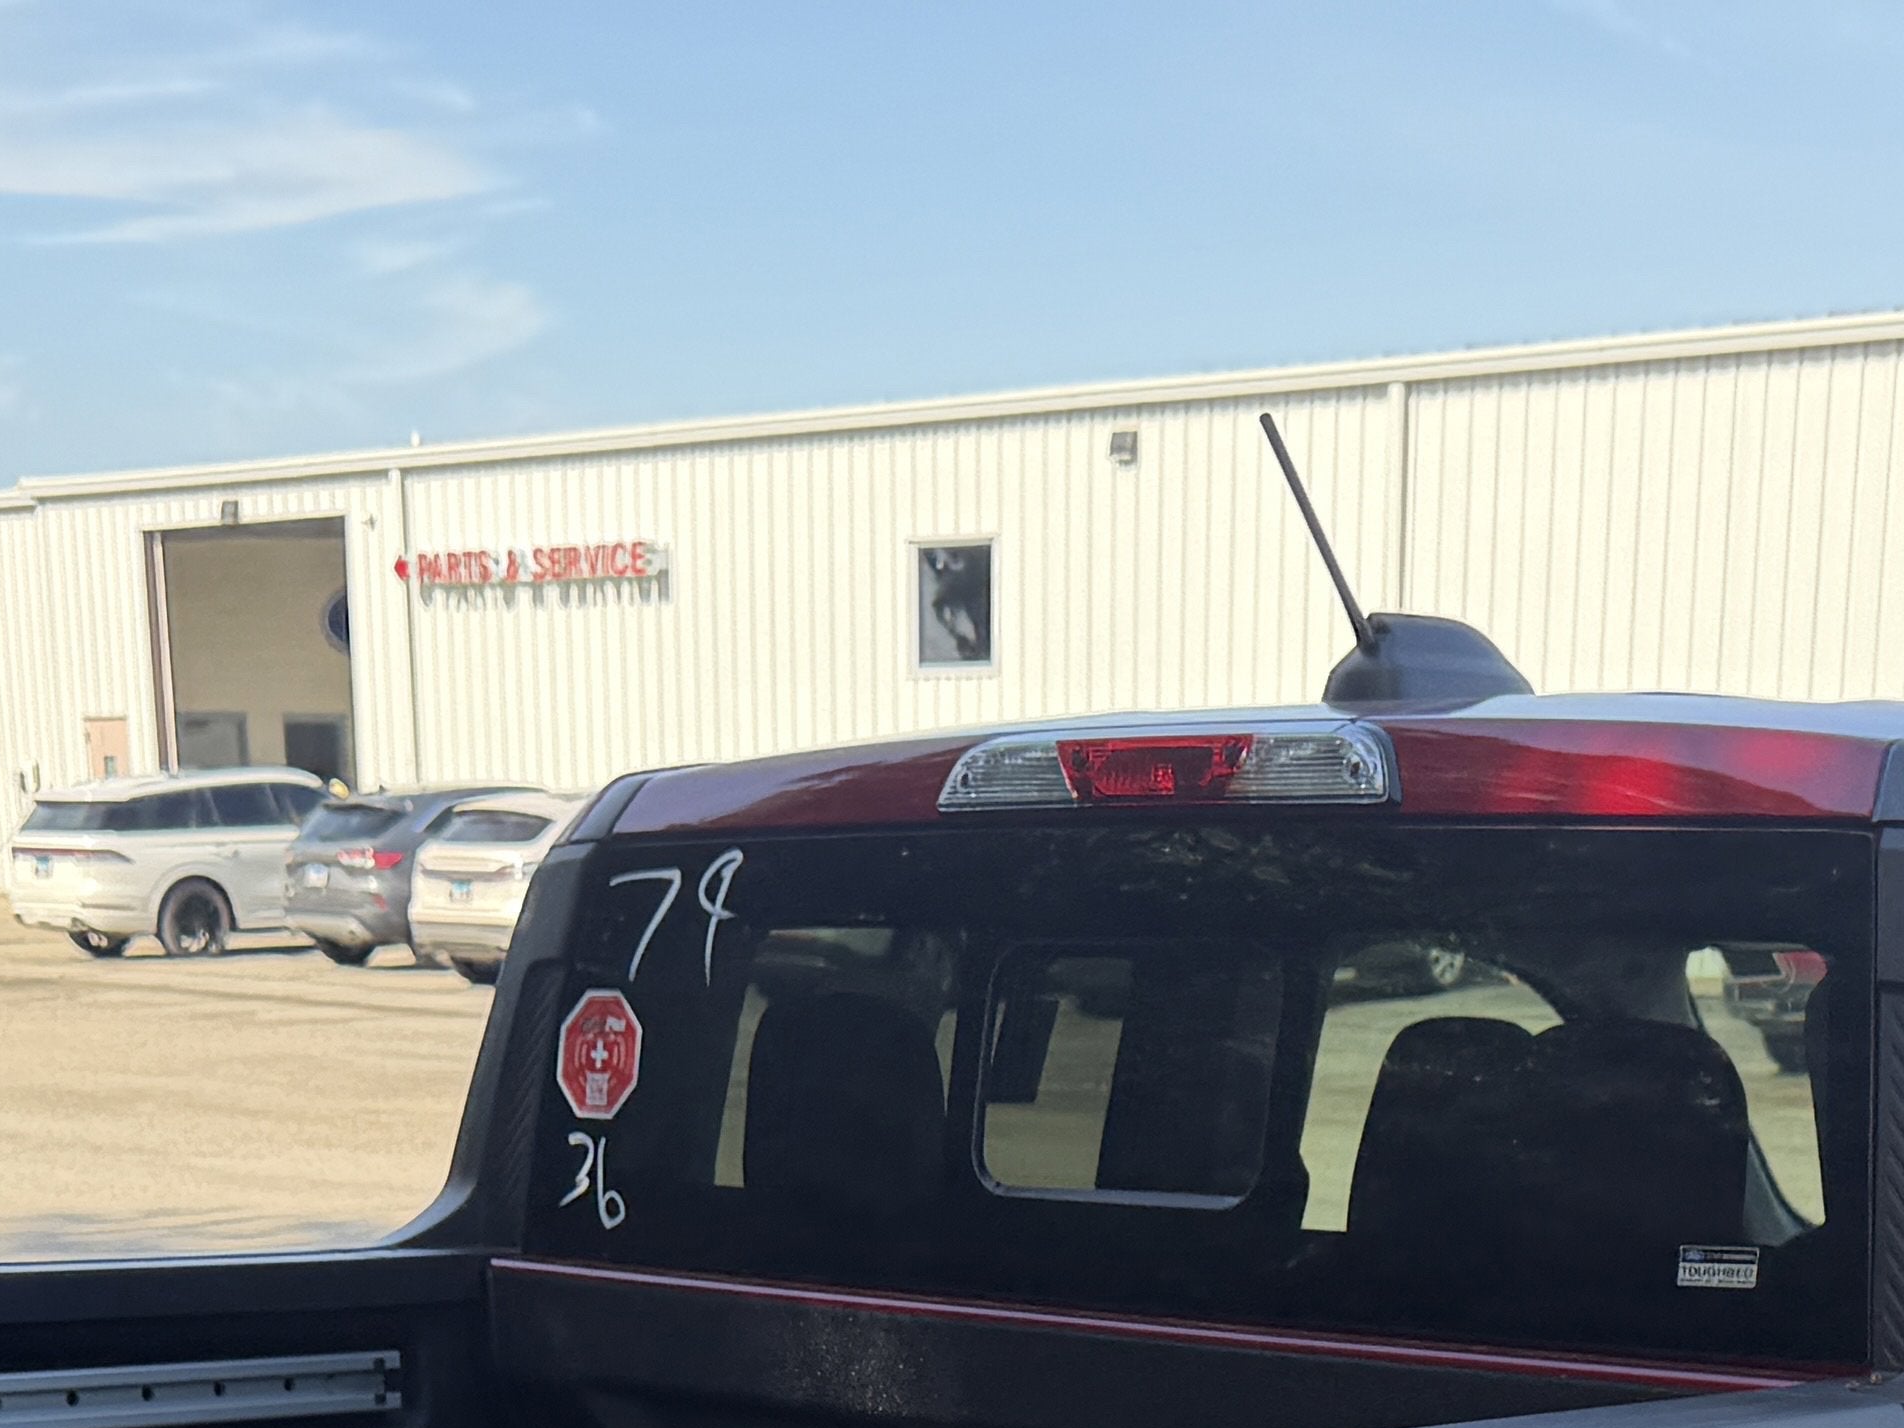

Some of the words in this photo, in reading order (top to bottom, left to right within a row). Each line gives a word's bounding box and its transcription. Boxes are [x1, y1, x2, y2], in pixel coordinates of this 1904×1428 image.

[418, 550, 492, 584] PARTS
[505, 549, 520, 582] &
[533, 541, 647, 583] SERVICE
[558, 1131, 626, 1230] 36
